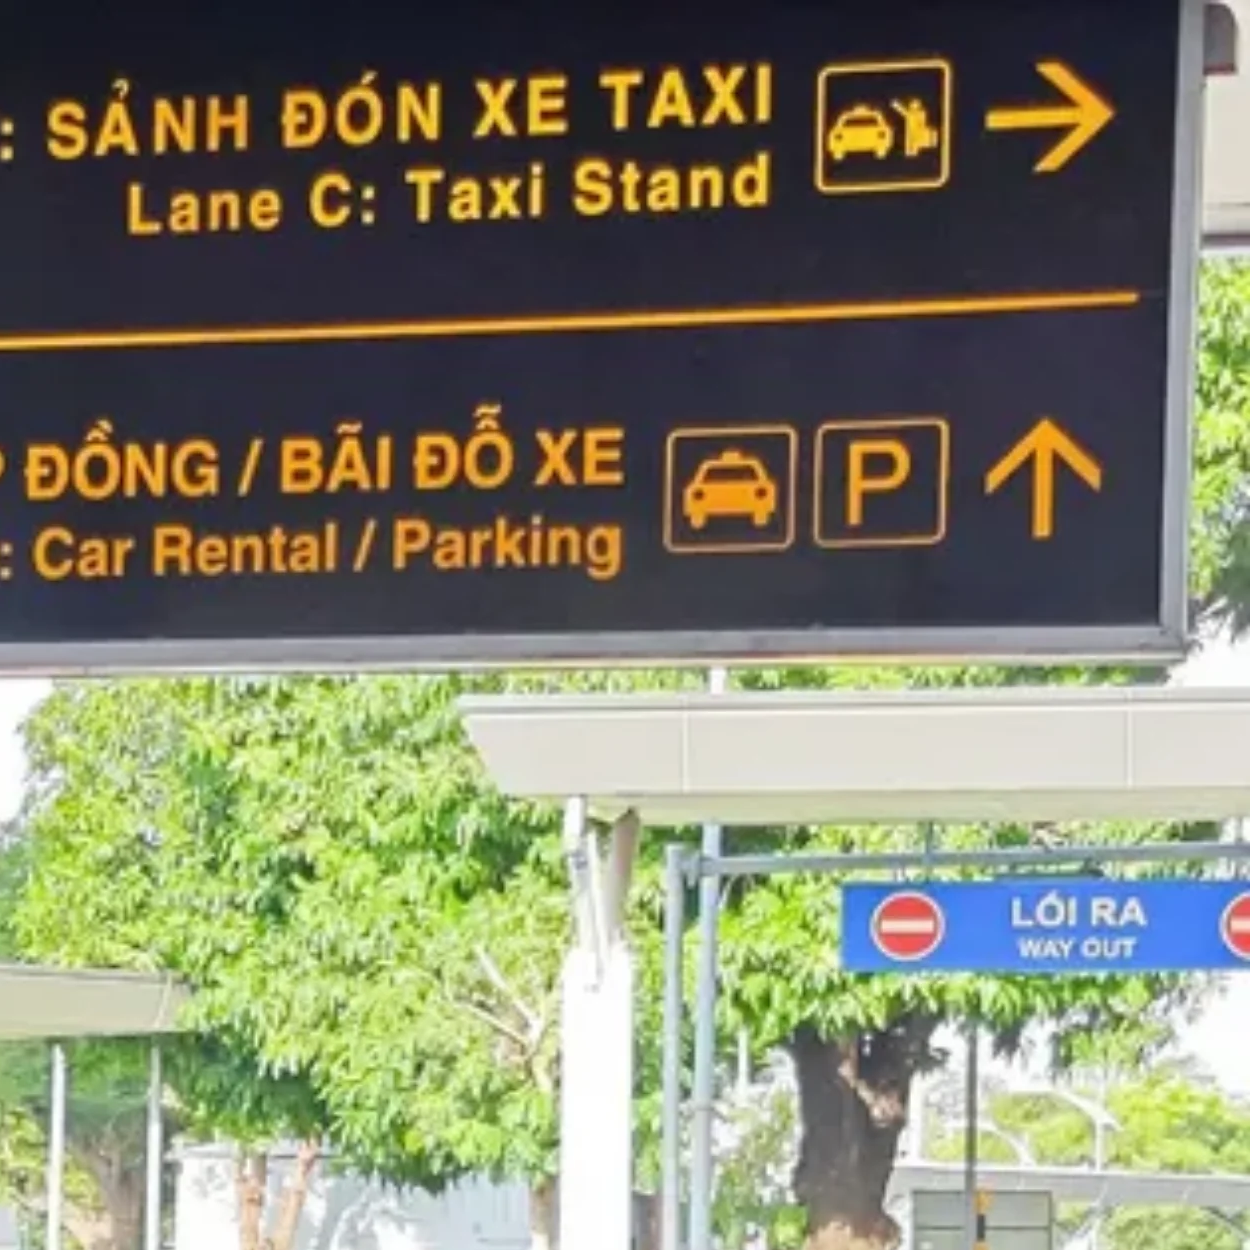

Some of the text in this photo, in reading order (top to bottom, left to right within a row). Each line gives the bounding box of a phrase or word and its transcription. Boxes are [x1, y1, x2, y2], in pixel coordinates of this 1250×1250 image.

[47, 78, 249, 160] SẢNH
[281, 72, 442, 148] ĐÓN
[476, 73, 567, 136] XE
[600, 64, 772, 129] TAXI
[128, 153, 771, 236] Lane C: Taxi Stand
[23, 418, 219, 500] ĐỒNG
[237, 440, 262, 497] /
[279, 421, 394, 497] BÃI
[412, 404, 514, 491] ĐỖ
[534, 426, 624, 487] XE
[846, 437, 912, 526] P
[31, 525, 134, 581] Car
[152, 521, 338, 576] Rental
[352, 522, 375, 574] /
[392, 515, 624, 581] Parking
[1017, 937, 1137, 958] WAY OUT
[1090, 896, 1149, 928] RA
